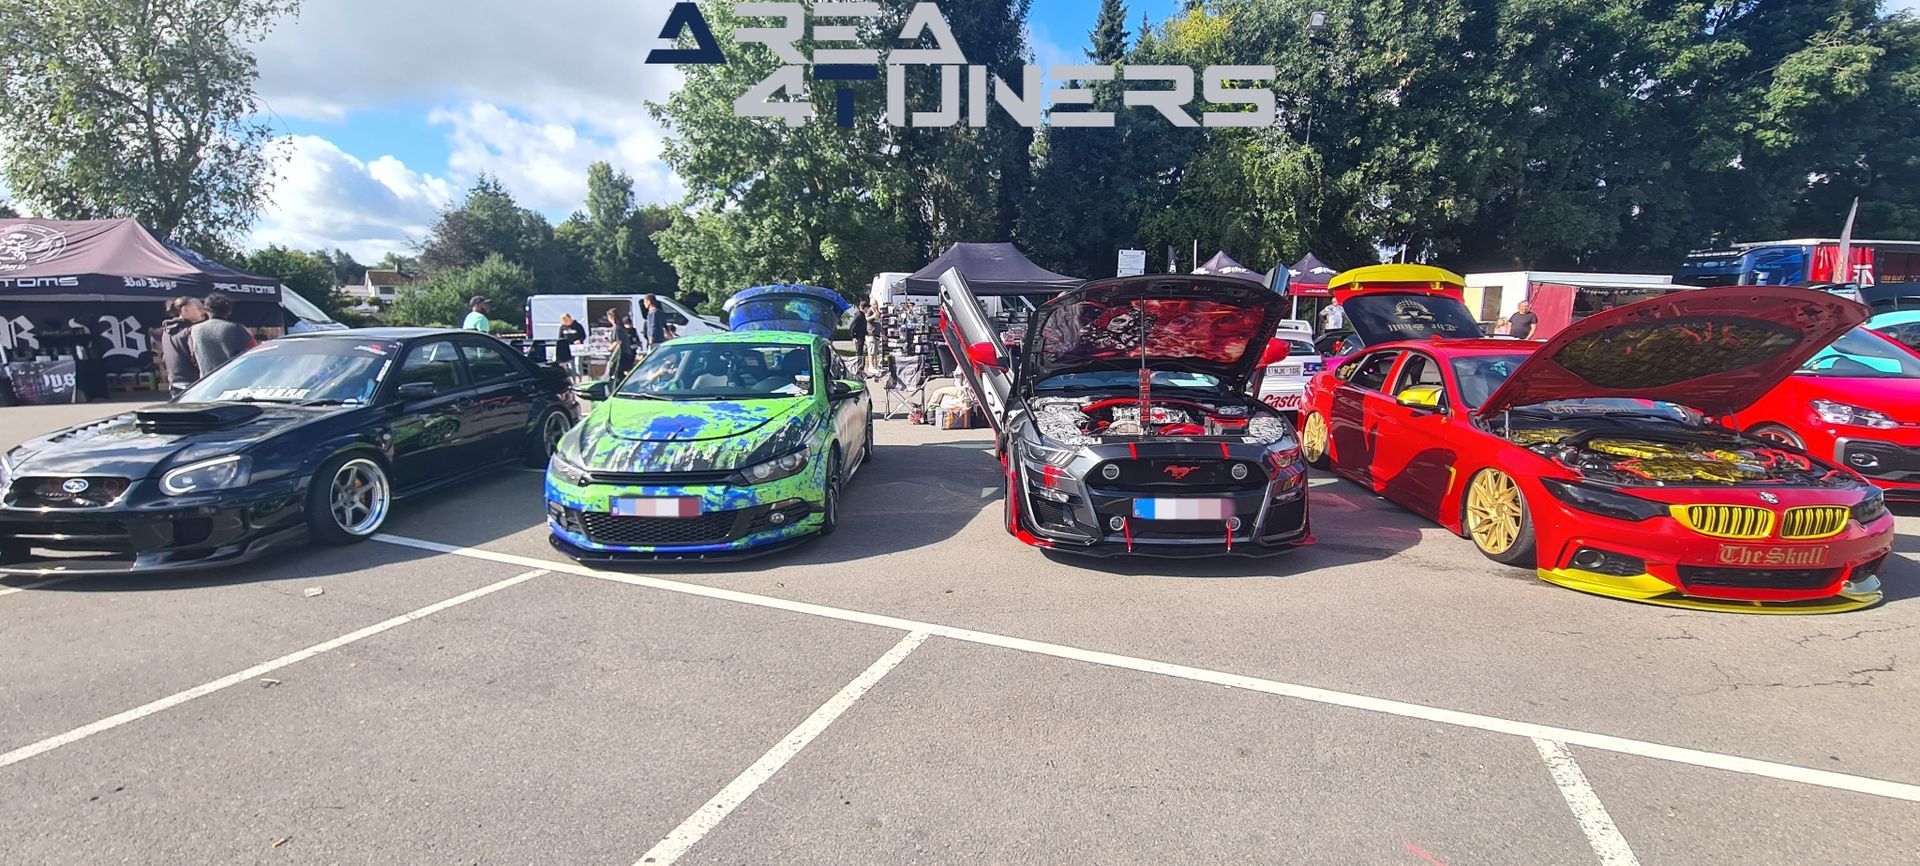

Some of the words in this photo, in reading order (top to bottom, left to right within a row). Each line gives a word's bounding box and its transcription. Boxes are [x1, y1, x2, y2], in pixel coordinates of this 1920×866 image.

[123, 276, 147, 287] Bad
[148, 278, 178, 290] Boys
[1387, 323, 1424, 332] Skull
[98, 315, 148, 358] B
